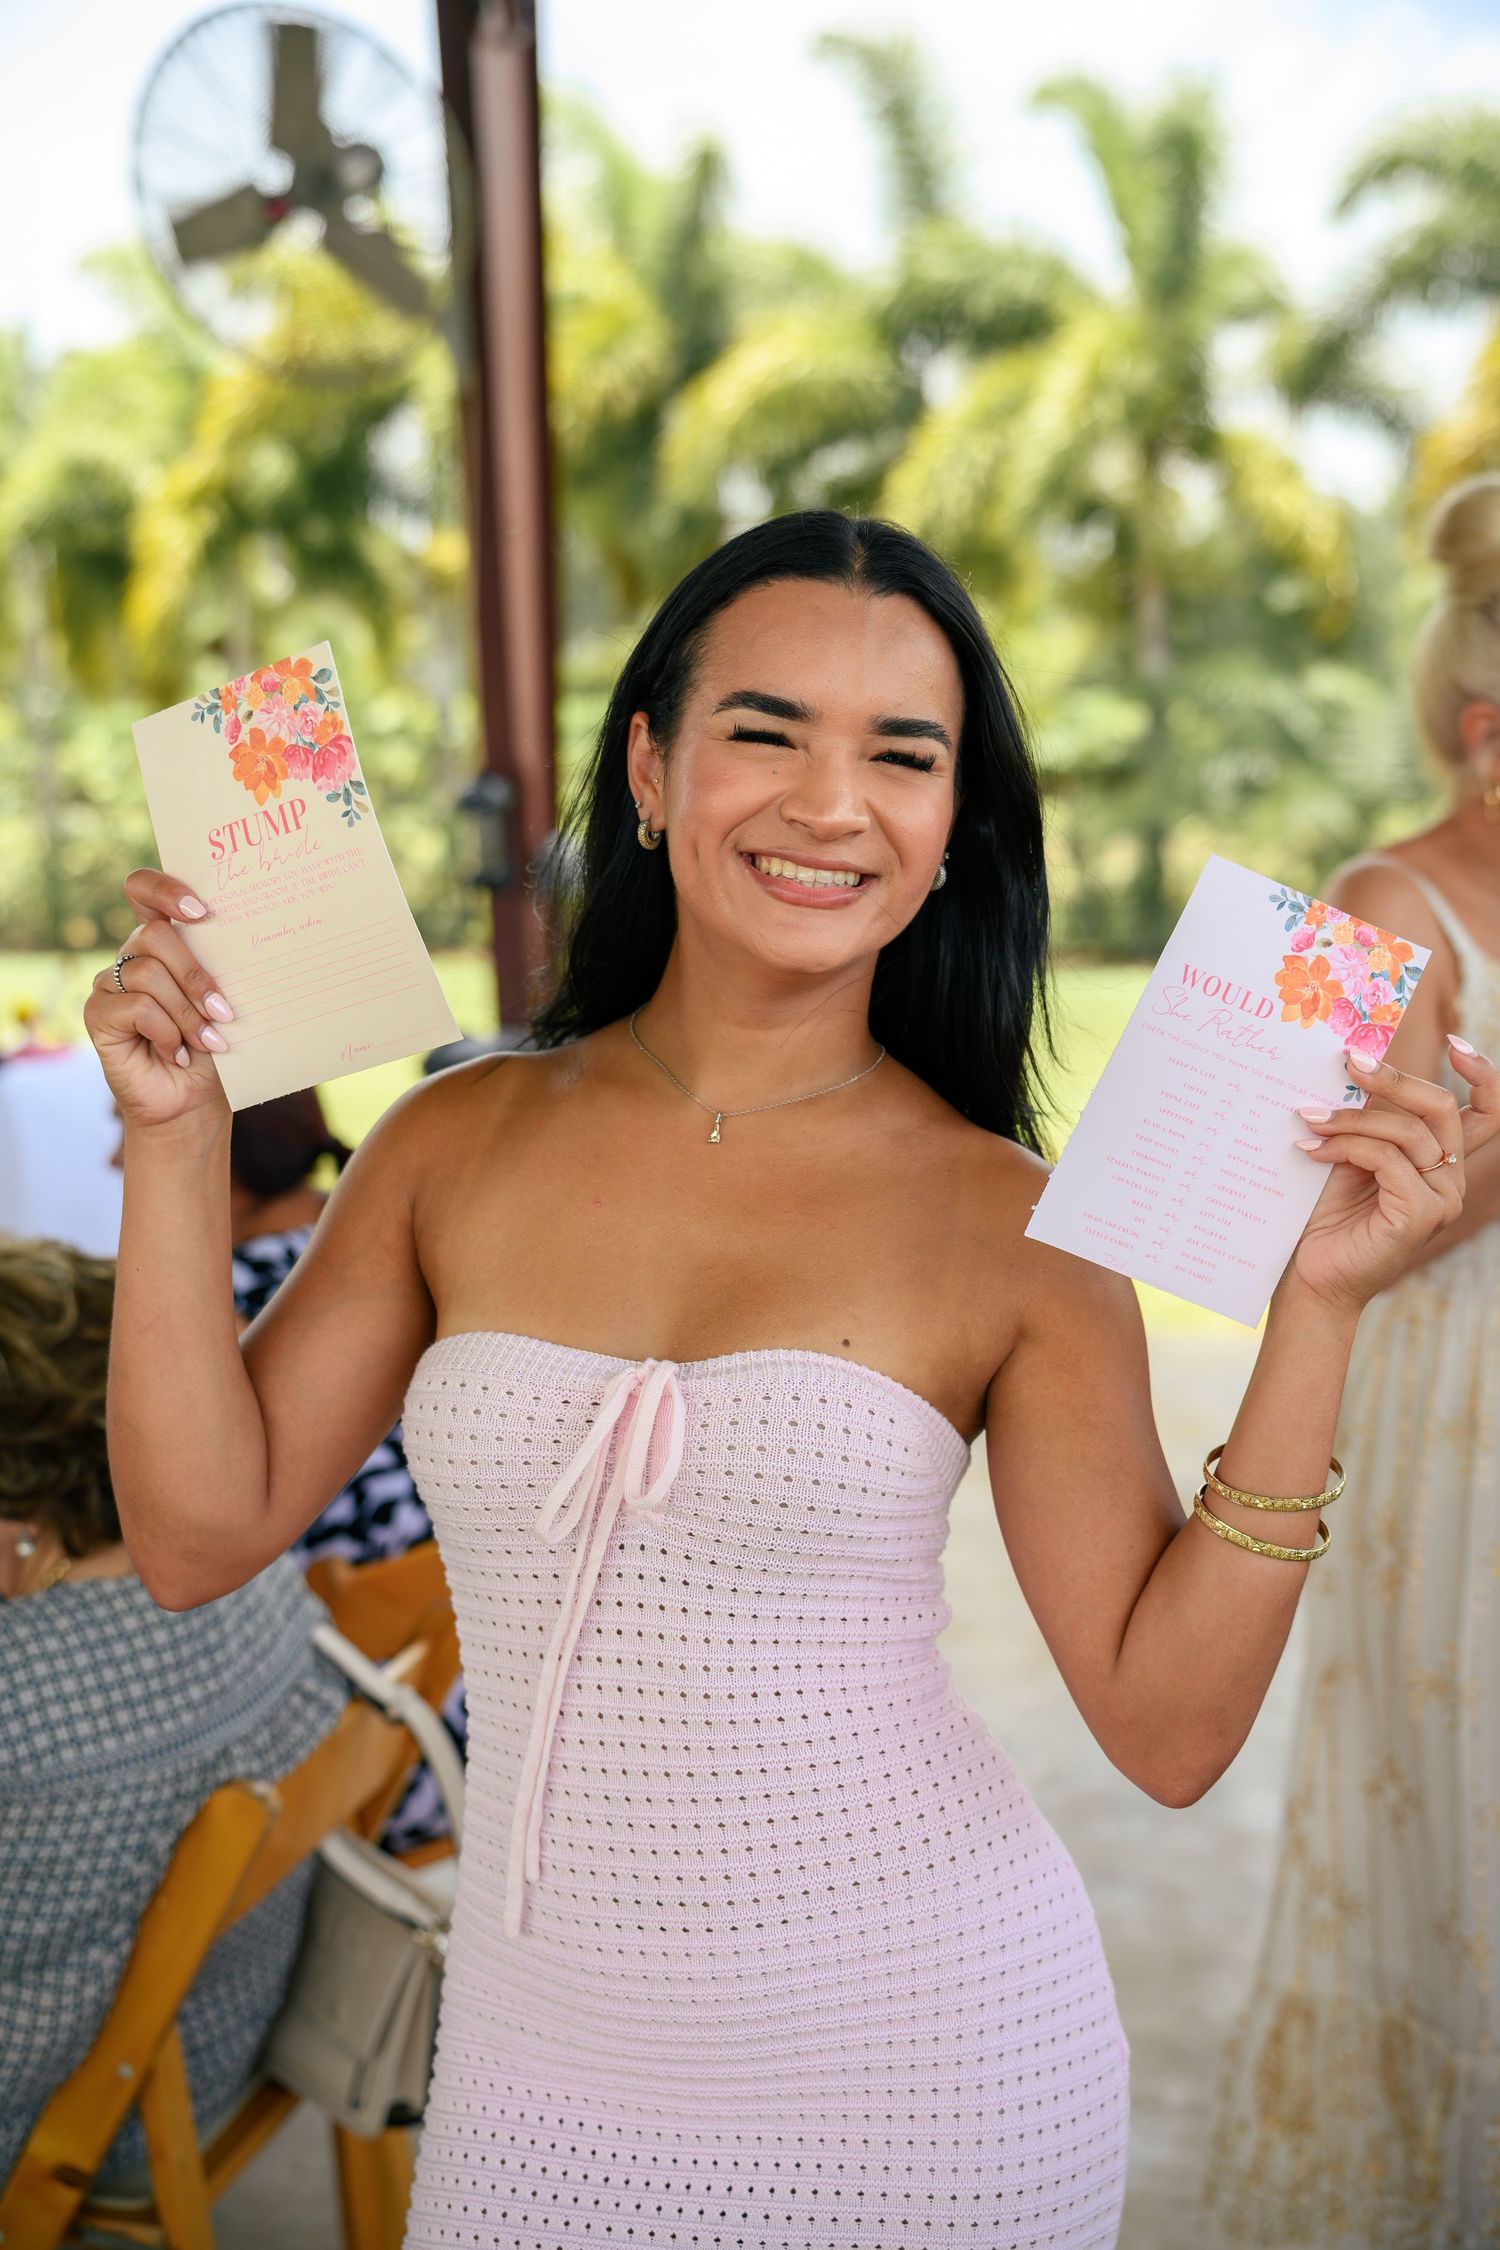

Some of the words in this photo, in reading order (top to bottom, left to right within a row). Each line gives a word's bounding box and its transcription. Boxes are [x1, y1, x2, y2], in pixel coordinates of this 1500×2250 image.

[208, 798, 306, 861] STUMP
[212, 849, 249, 891] the
[259, 823, 323, 873] bride
[249, 875, 281, 890] MEMORY
[301, 862, 321, 874] HAVE
[282, 895, 297, 906] ARE
[318, 867, 342, 881] BRIDE
[1181, 963, 1274, 1020] WOULD
[1142, 1022, 1165, 1036] CHECK
[1168, 1032, 1181, 1042] THE
[1182, 1039, 1209, 1055] CHOICE
[1212, 1051, 1226, 1062] YOU
[1229, 1057, 1249, 1071] THINK
[1251, 1067, 1264, 1077] THE
[1152, 985, 1195, 1022] She
[1198, 1008, 1284, 1061] Rather
